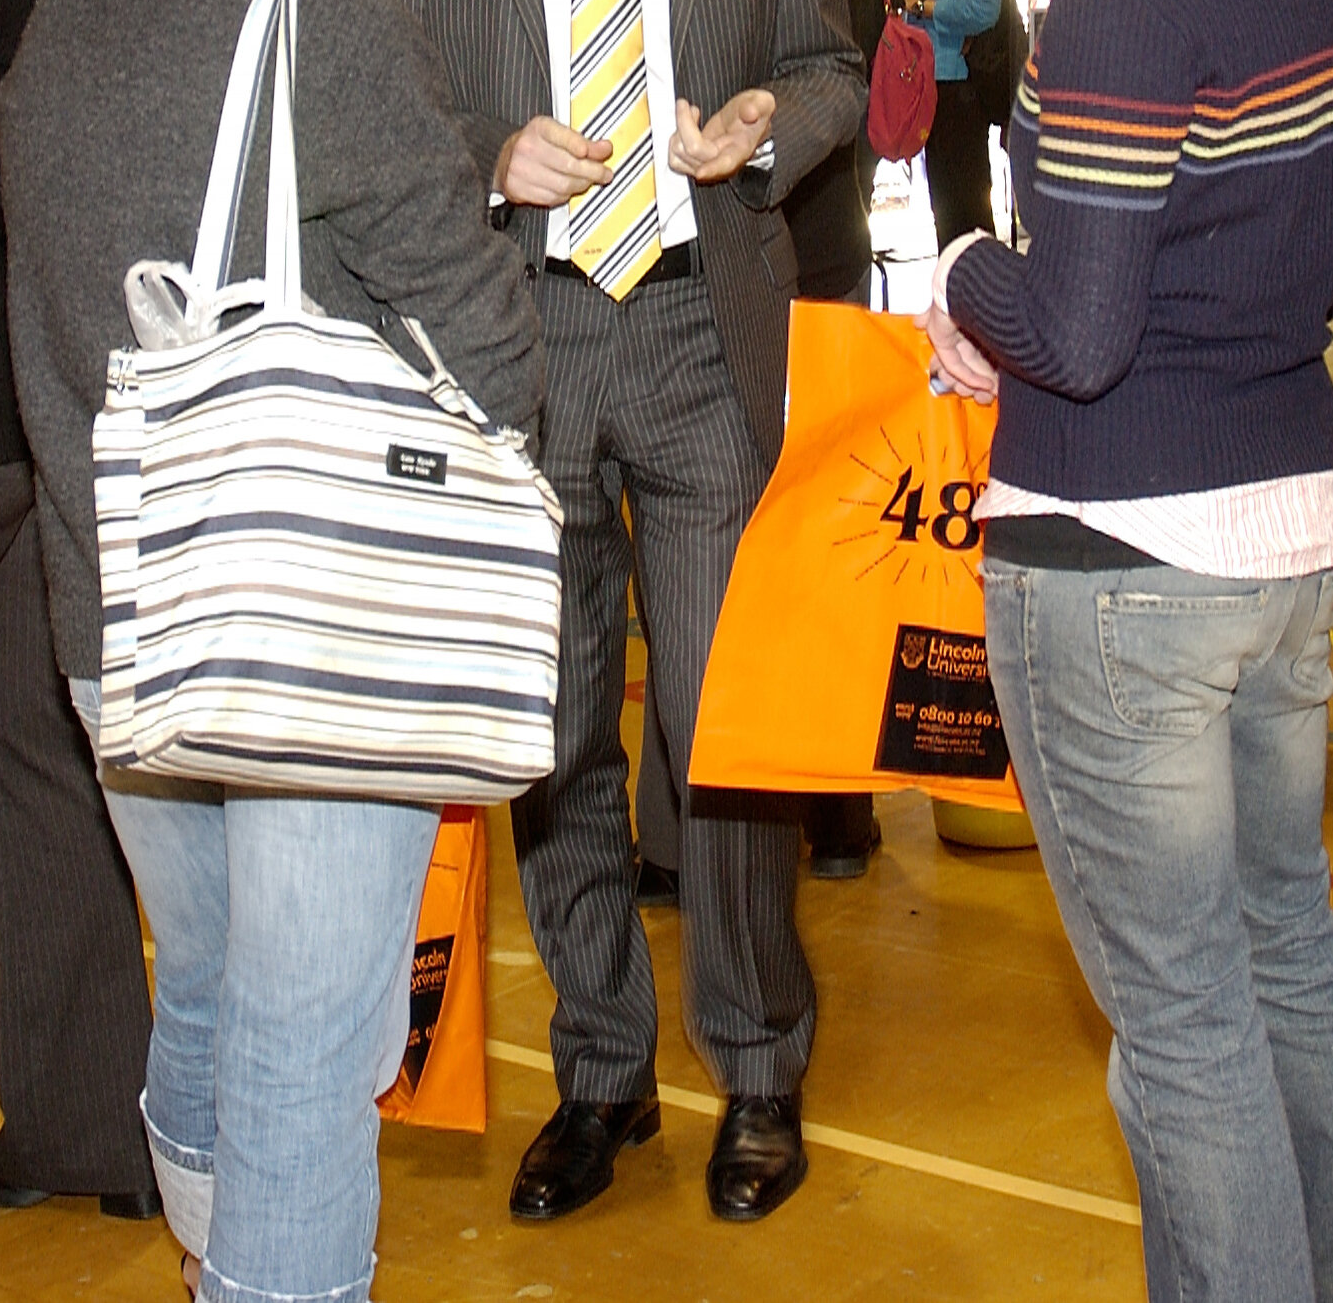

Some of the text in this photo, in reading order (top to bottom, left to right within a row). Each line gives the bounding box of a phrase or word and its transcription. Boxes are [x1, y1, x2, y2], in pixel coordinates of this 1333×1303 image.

[928, 636, 986, 662] Lincoln
[927, 655, 987, 677] Universi
[919, 704, 955, 725] 0800
[974, 710, 993, 727] 60
